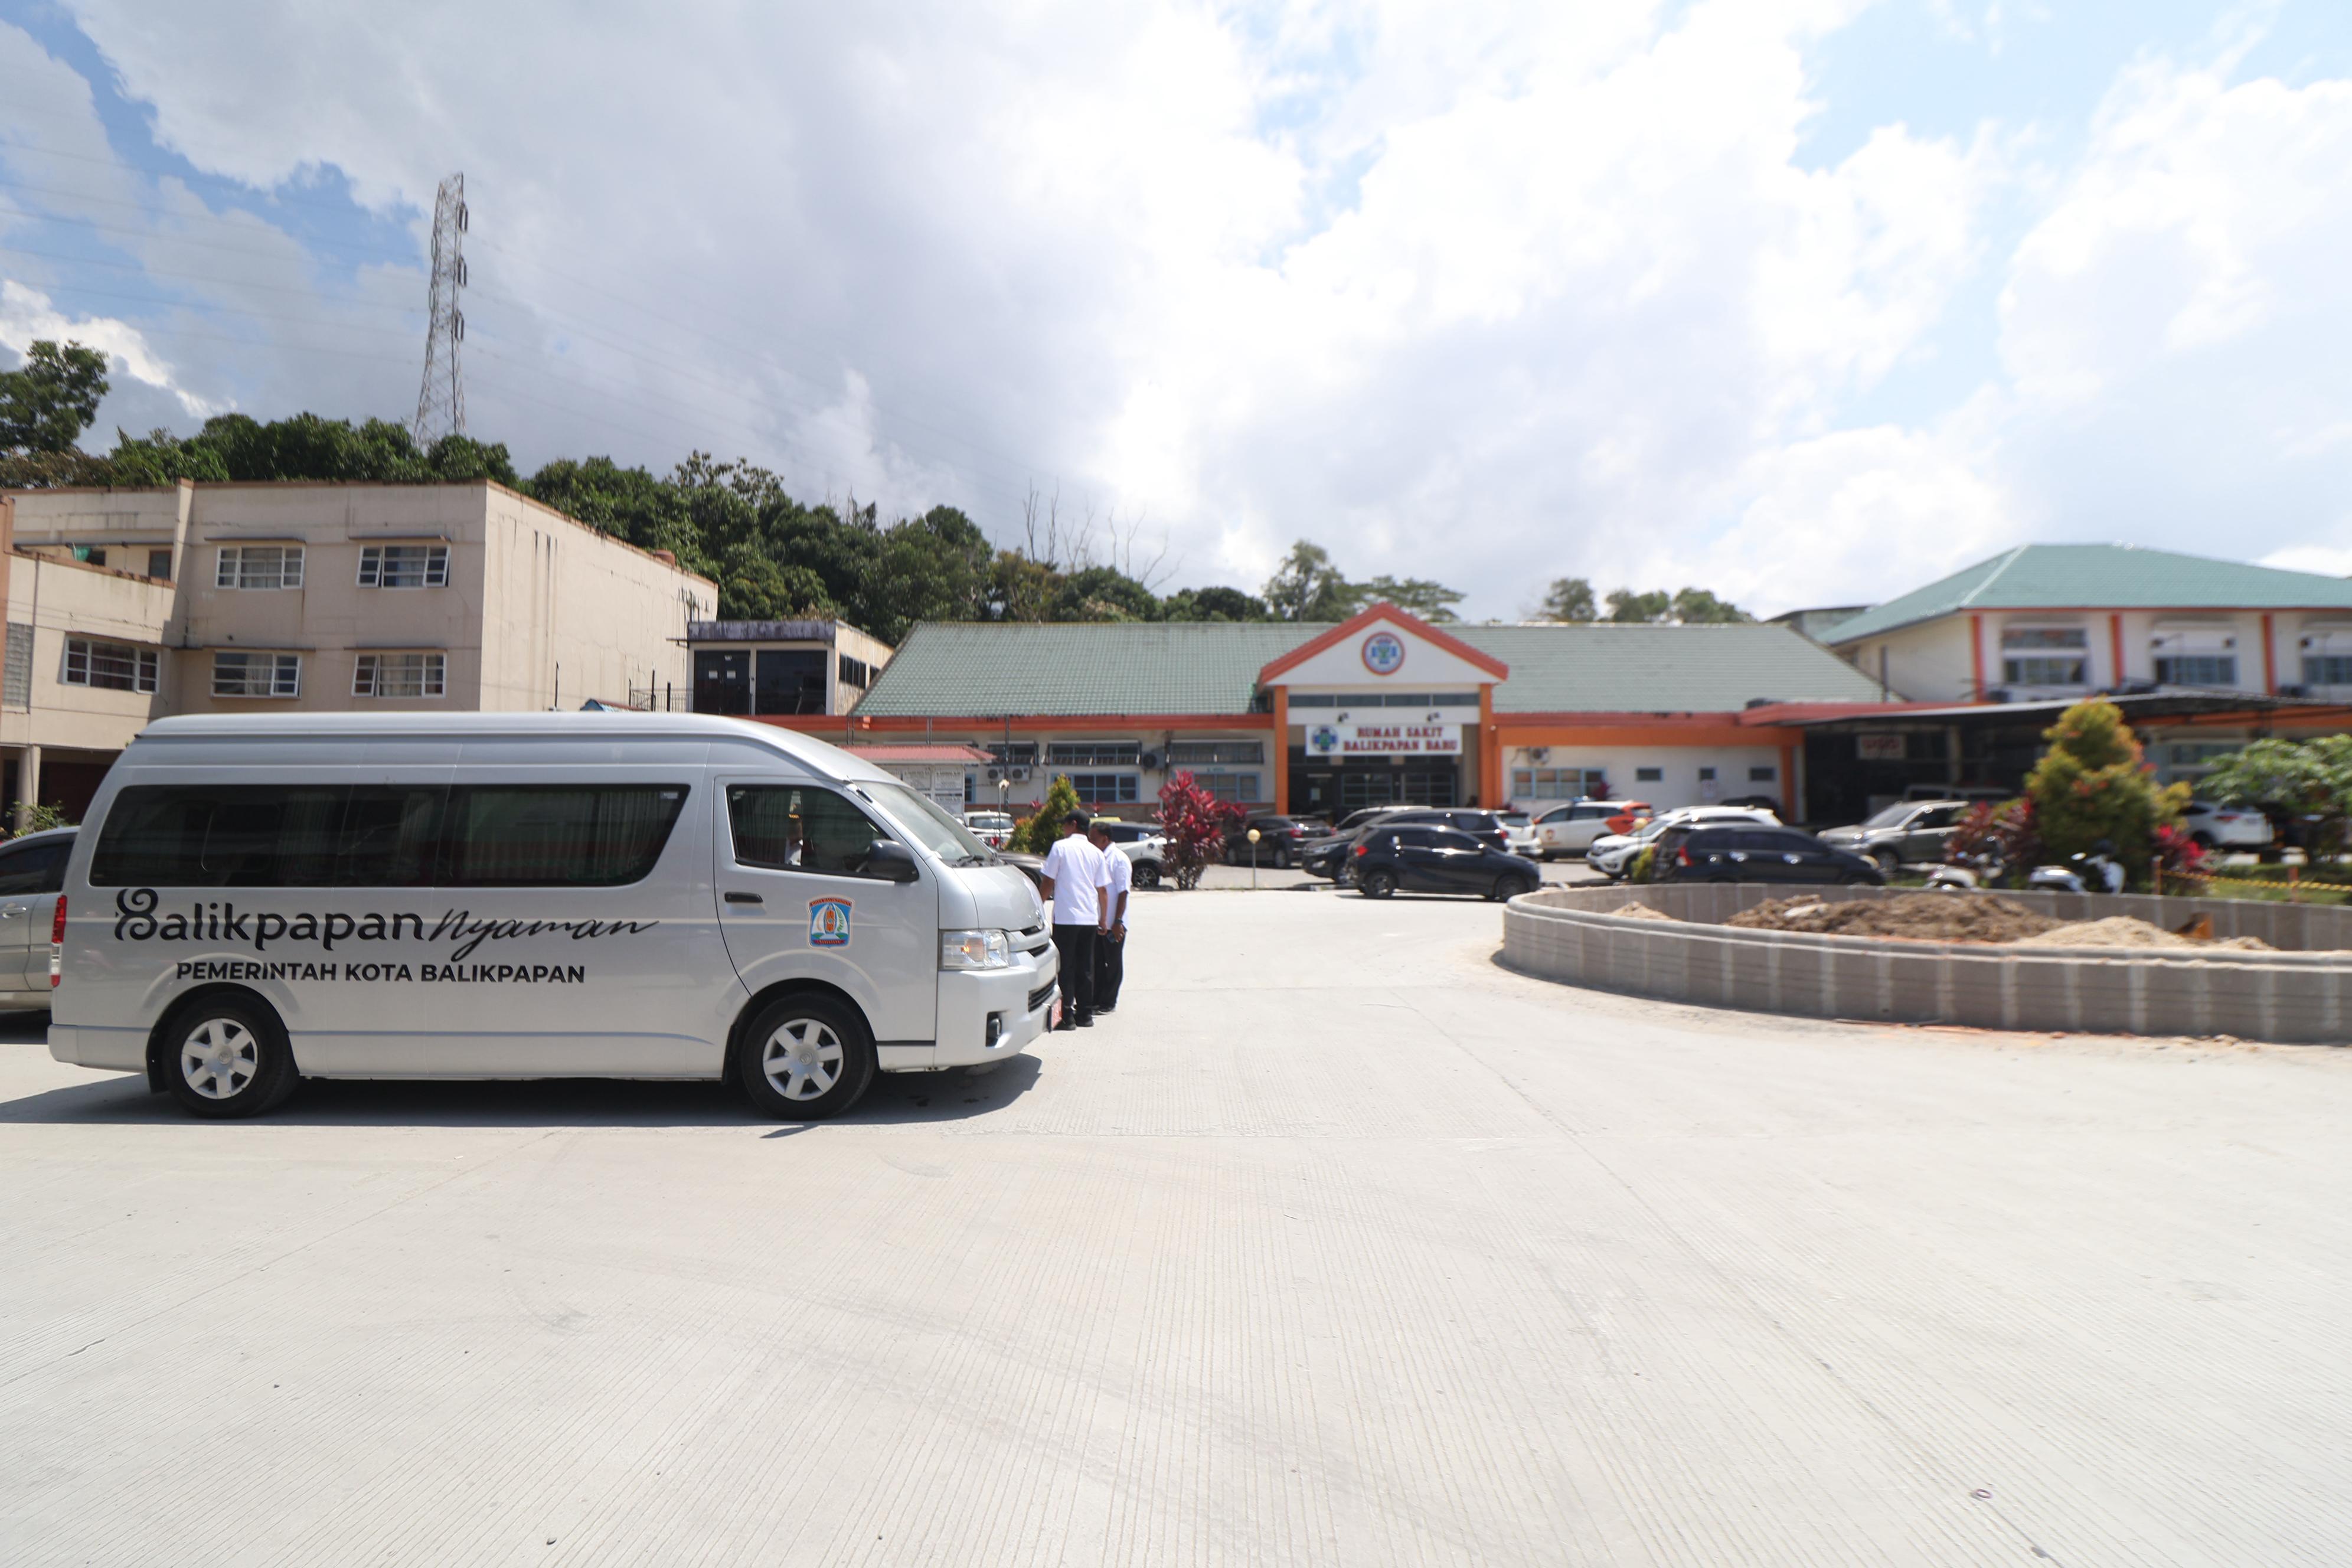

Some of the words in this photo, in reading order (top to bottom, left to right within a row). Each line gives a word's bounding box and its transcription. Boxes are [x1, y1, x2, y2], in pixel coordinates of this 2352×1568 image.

[1357, 727, 1400, 737] RUMAH
[1407, 727, 1443, 737] SAKIT
[1344, 740, 1419, 752] BALIKPAPAN
[1426, 740, 1457, 751] BARU
[115, 888, 425, 951] Balikpapan
[177, 962, 337, 981] PEMERINTAH
[345, 963, 413, 982] KOTA
[421, 965, 585, 983] BALIKPAPAN
